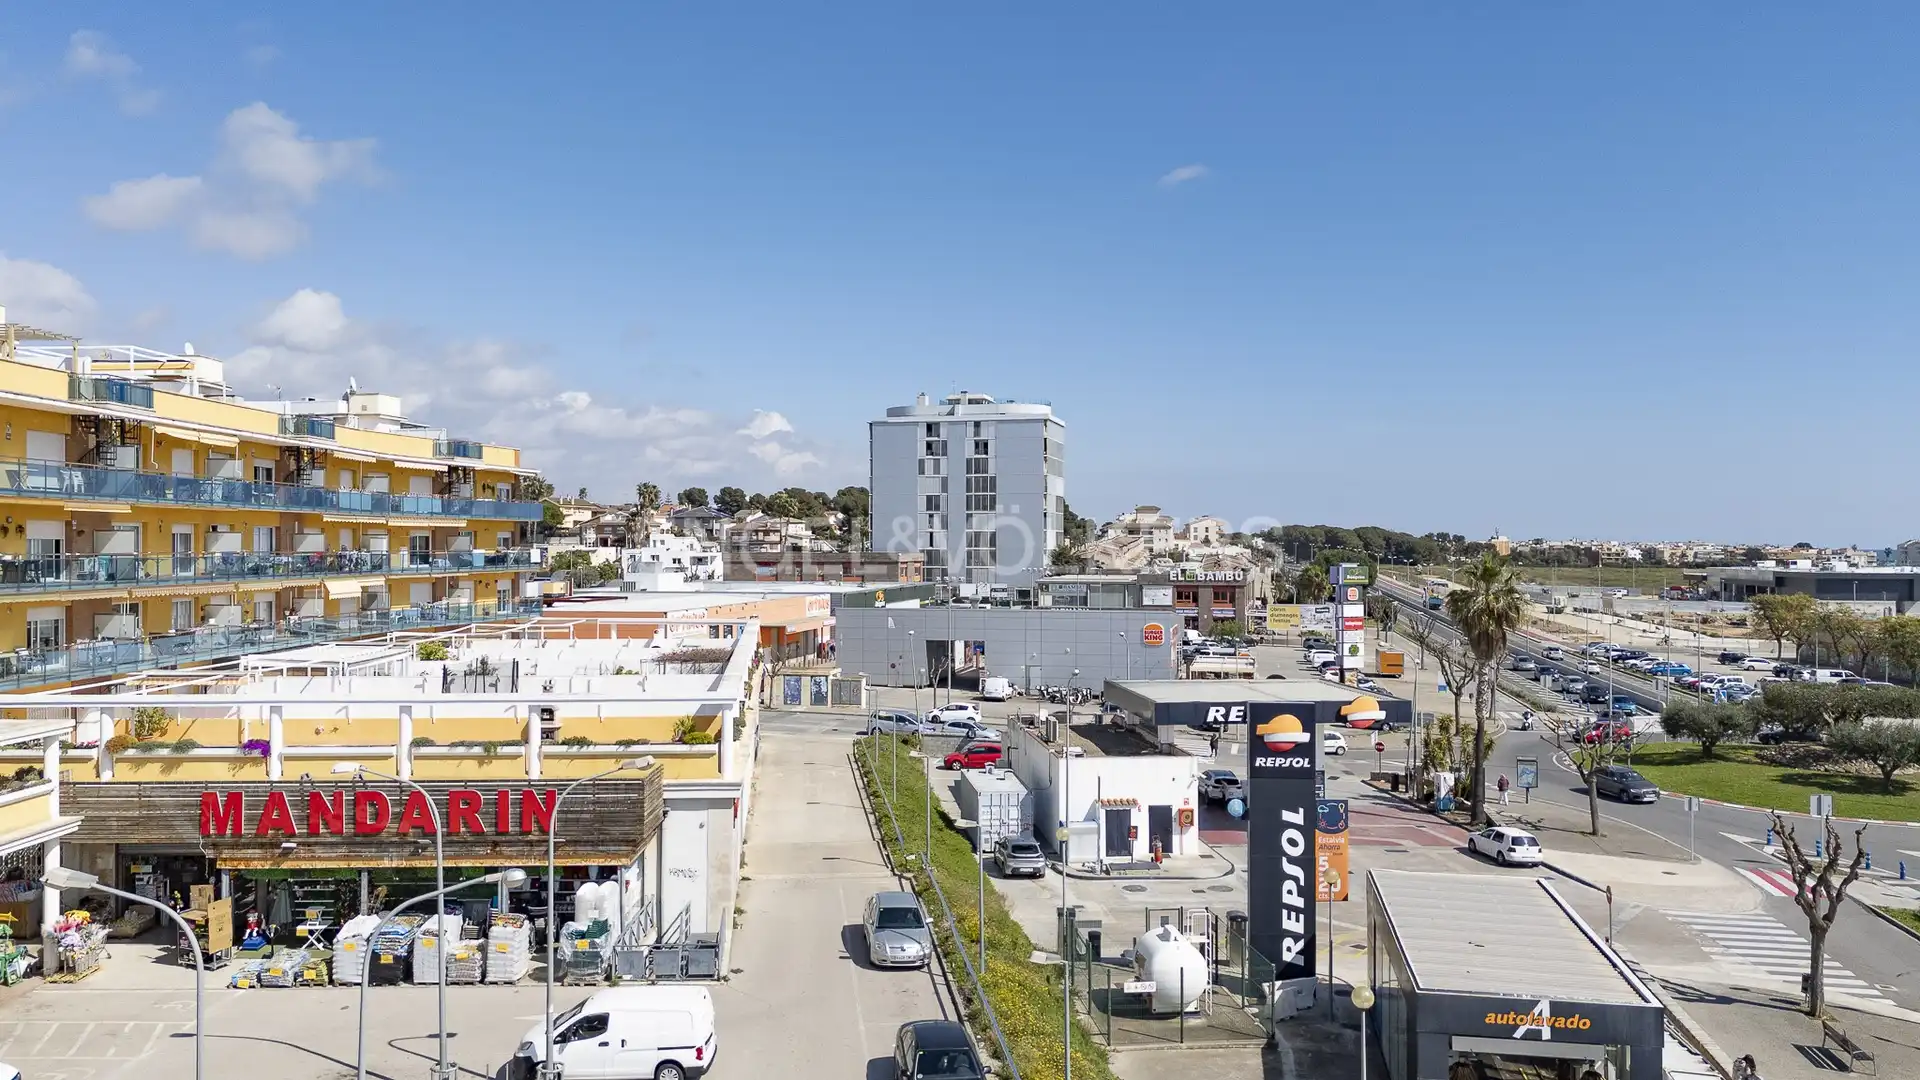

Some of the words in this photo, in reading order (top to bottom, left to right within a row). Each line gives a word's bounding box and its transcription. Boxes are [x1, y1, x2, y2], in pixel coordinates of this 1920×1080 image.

[1169, 570, 1184, 581] EL
[1206, 706, 1247, 723] RE
[1254, 757, 1311, 768] REPSOL
[200, 788, 558, 837] MANDARIN
[1281, 807, 1304, 967] REPSOL
[1484, 1010, 1591, 1030] autolavado
